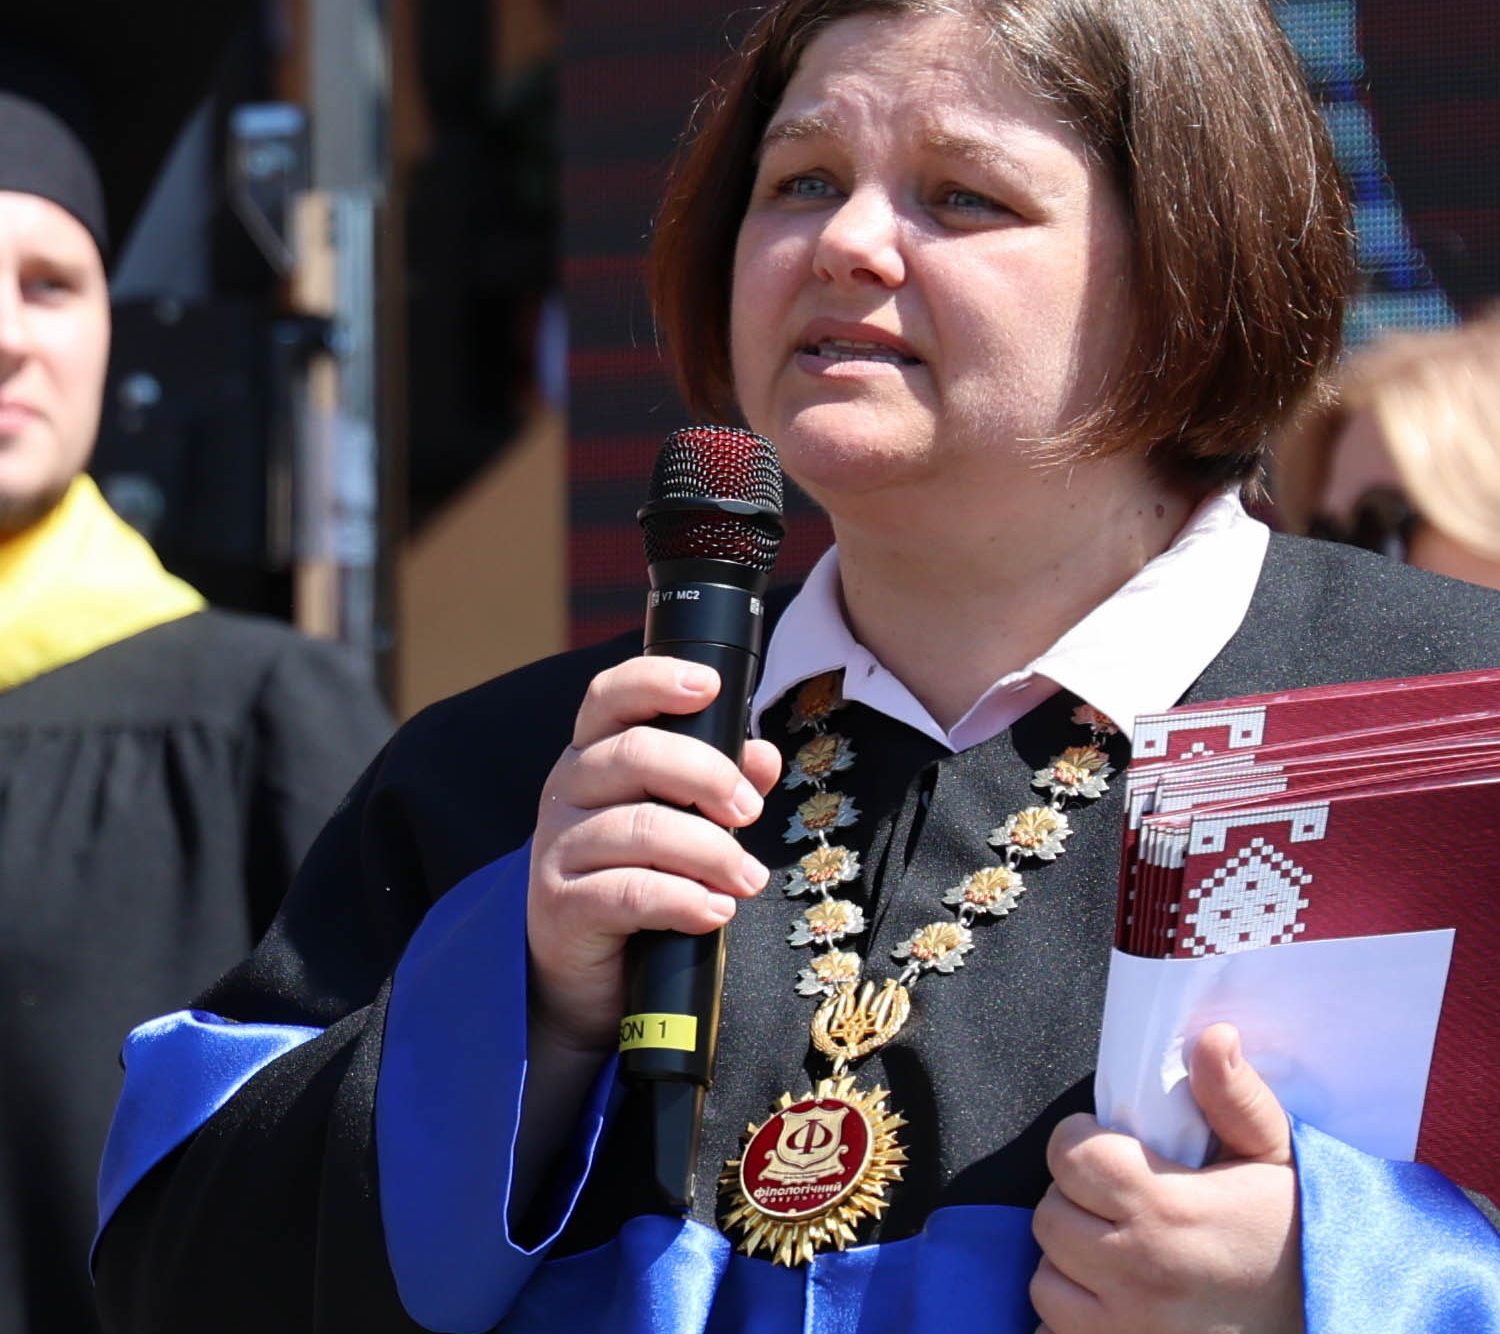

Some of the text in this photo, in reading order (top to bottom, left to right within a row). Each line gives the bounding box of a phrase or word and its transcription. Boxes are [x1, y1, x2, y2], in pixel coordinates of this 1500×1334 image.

[676, 589, 701, 600] MC2
[658, 1020, 668, 1039] 1
[786, 1118, 833, 1155] Ф
[754, 1182, 842, 1199] філологічний
